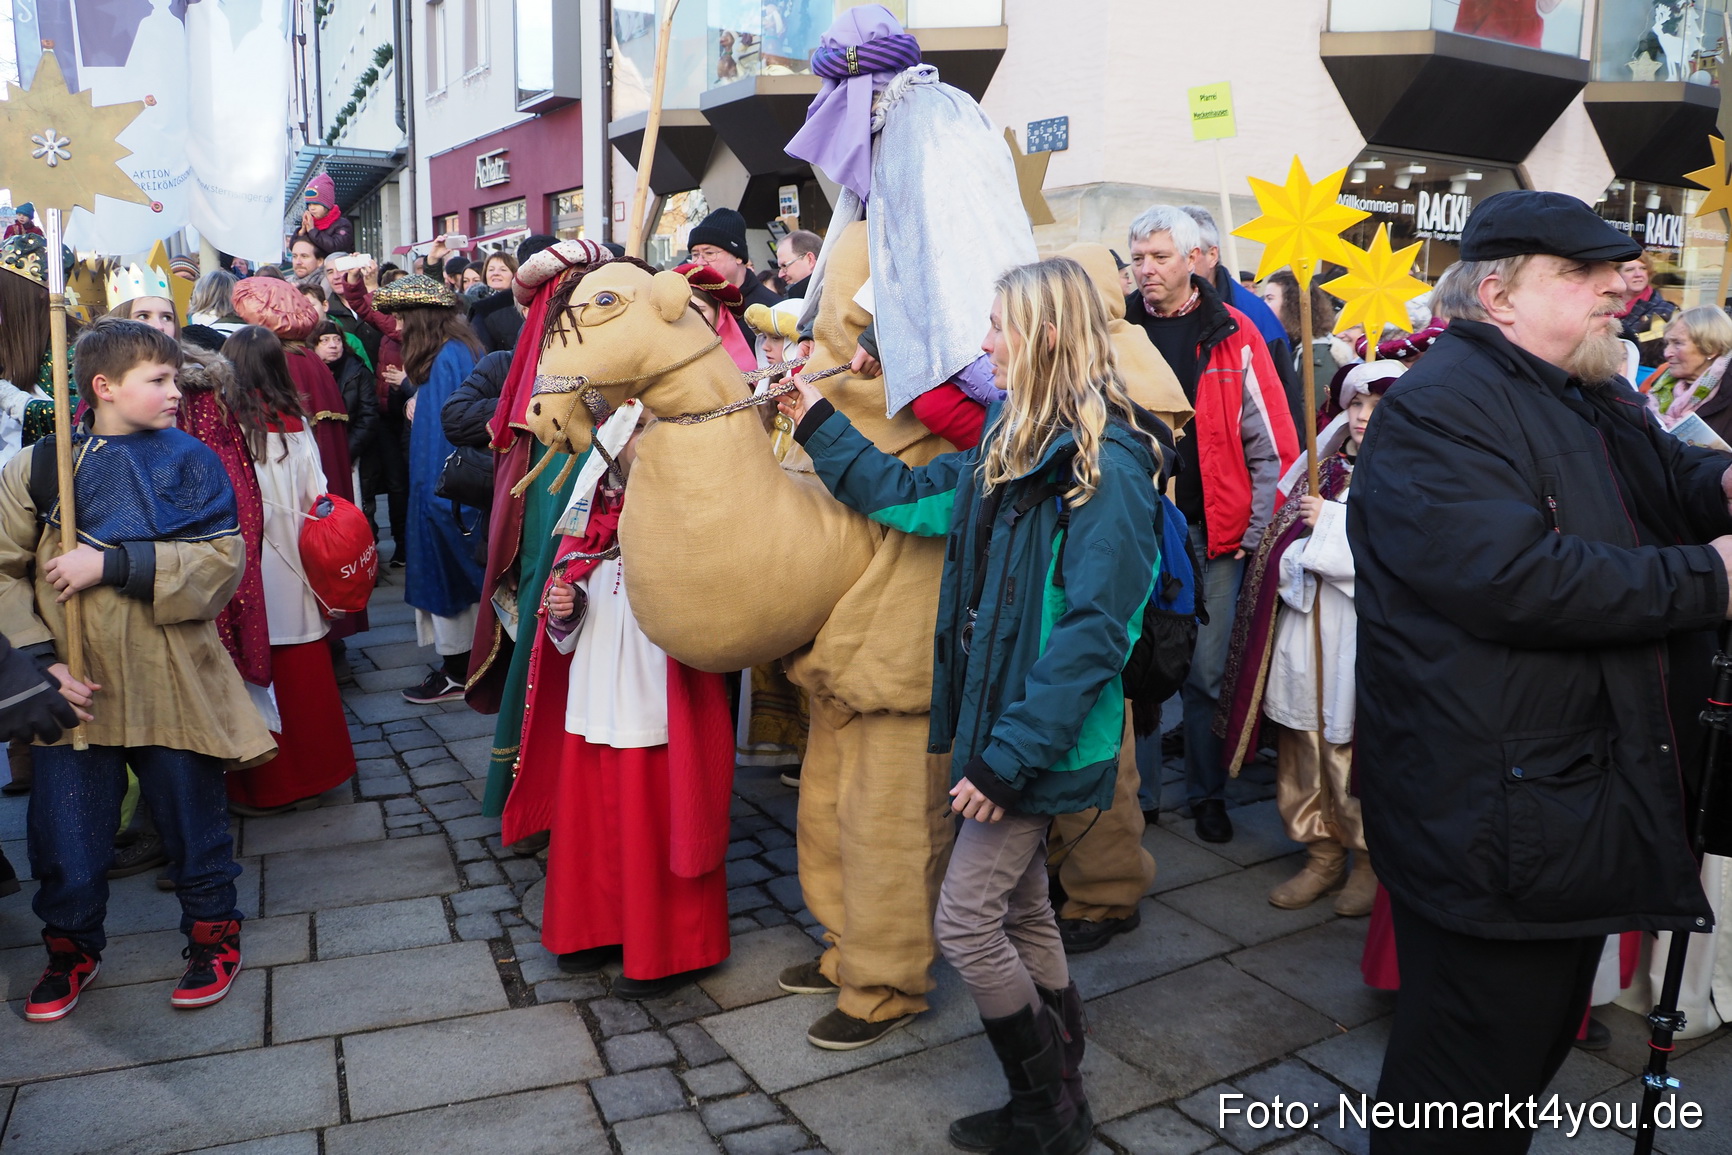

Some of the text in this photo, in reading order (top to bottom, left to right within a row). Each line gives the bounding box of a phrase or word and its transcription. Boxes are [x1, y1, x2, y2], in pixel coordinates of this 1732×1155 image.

[133, 168, 171, 180] AKTION
[474, 147, 510, 190] Achatz
[1336, 193, 1399, 213] Willkommen
[1401, 200, 1415, 215] im
[1635, 220, 1645, 232] im
[1644, 211, 1684, 247] RACKL
[340, 560, 357, 579] SV
